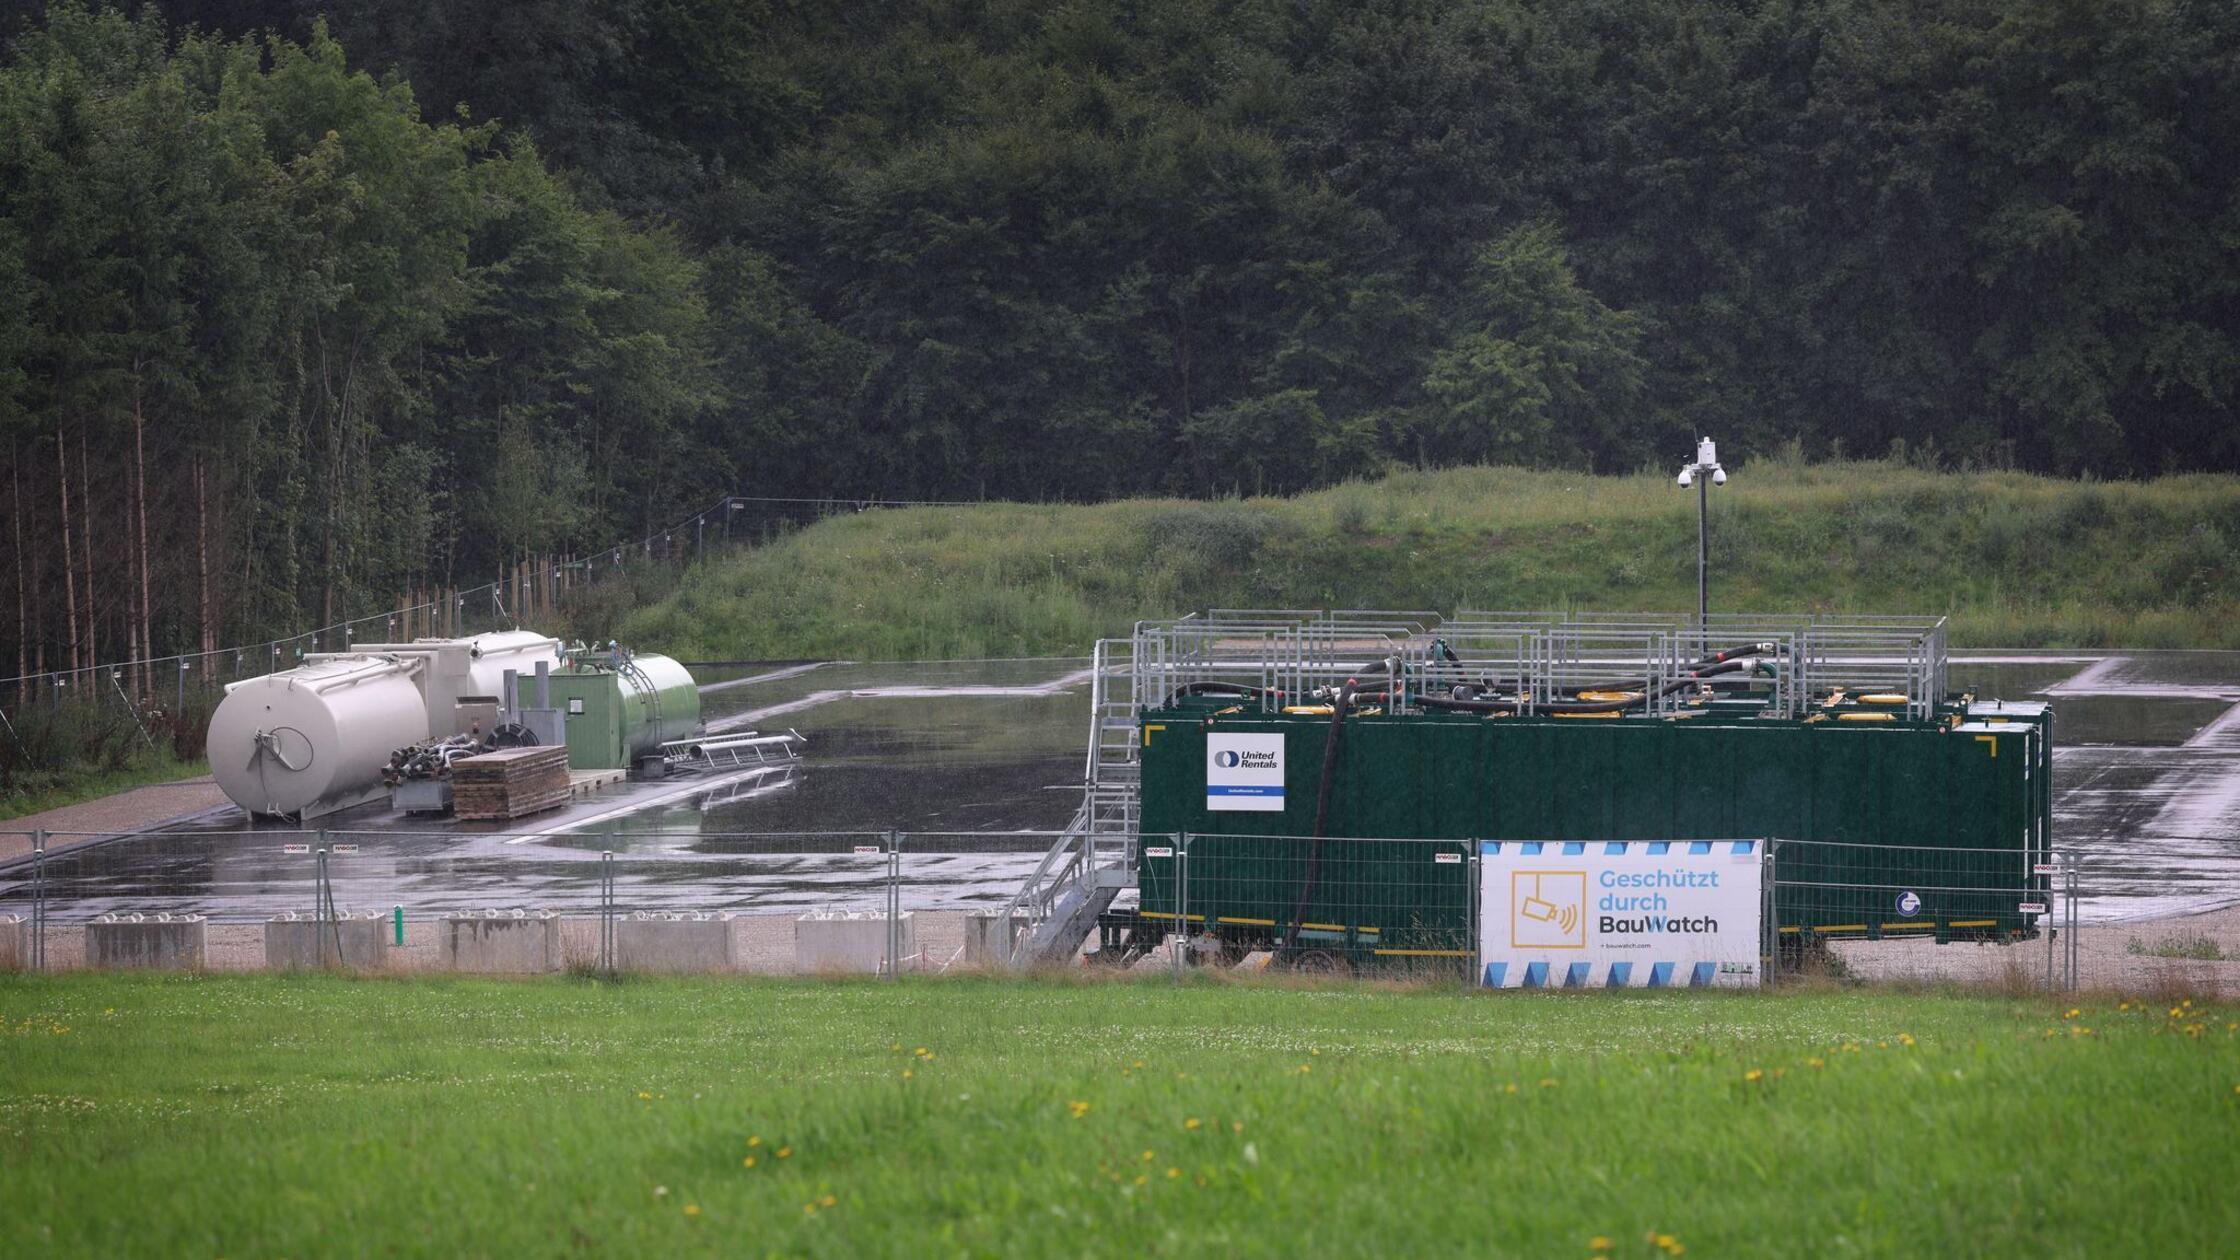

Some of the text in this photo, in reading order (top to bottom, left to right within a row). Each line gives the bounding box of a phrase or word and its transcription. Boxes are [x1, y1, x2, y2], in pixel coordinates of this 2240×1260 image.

[1241, 751, 1274, 760] United
[1241, 760, 1277, 769] Rentals
[1599, 869, 1719, 888] Geschützt
[1599, 893, 1667, 911] durch
[1599, 916, 1718, 933] BauWatch
